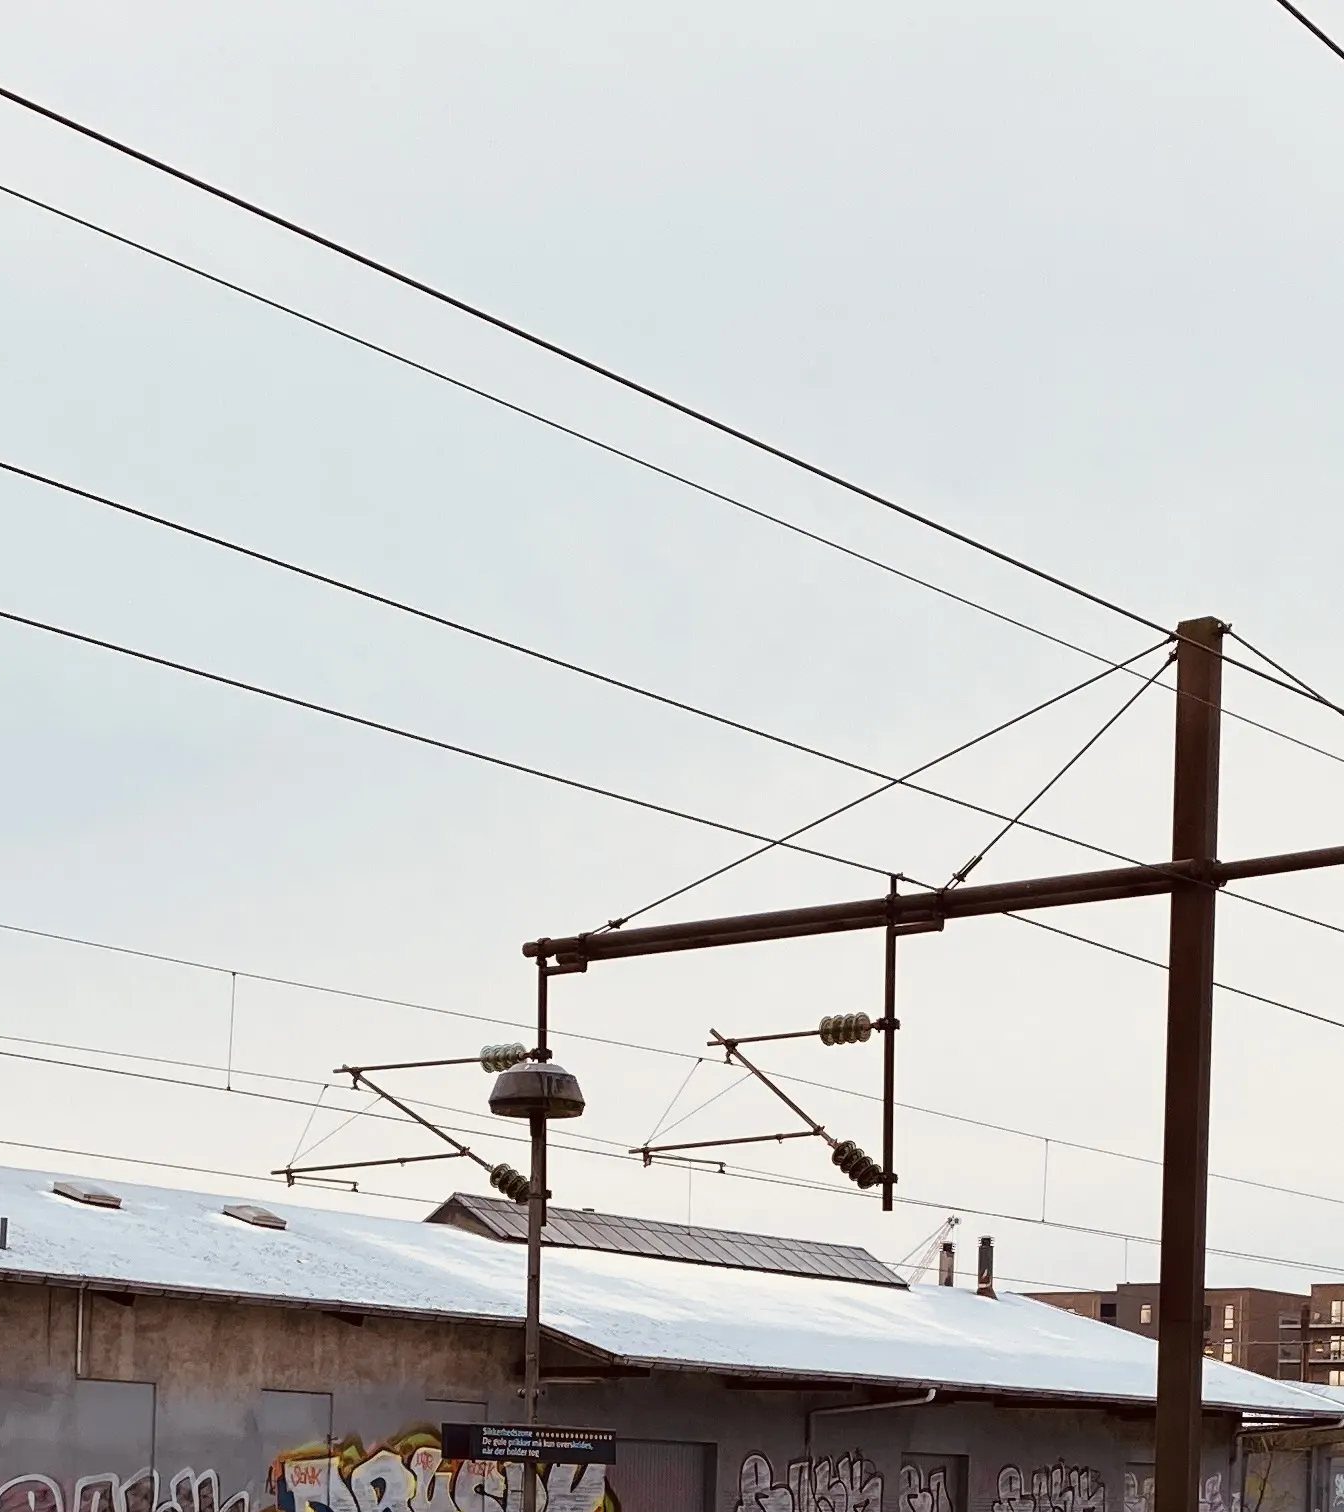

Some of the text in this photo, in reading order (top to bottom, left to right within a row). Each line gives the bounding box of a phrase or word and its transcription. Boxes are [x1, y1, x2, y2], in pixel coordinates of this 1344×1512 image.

[482, 1437, 492, 1445] De
[543, 1440, 555, 1448] kun
[494, 1447, 506, 1456] der
[506, 1447, 527, 1457] holder
